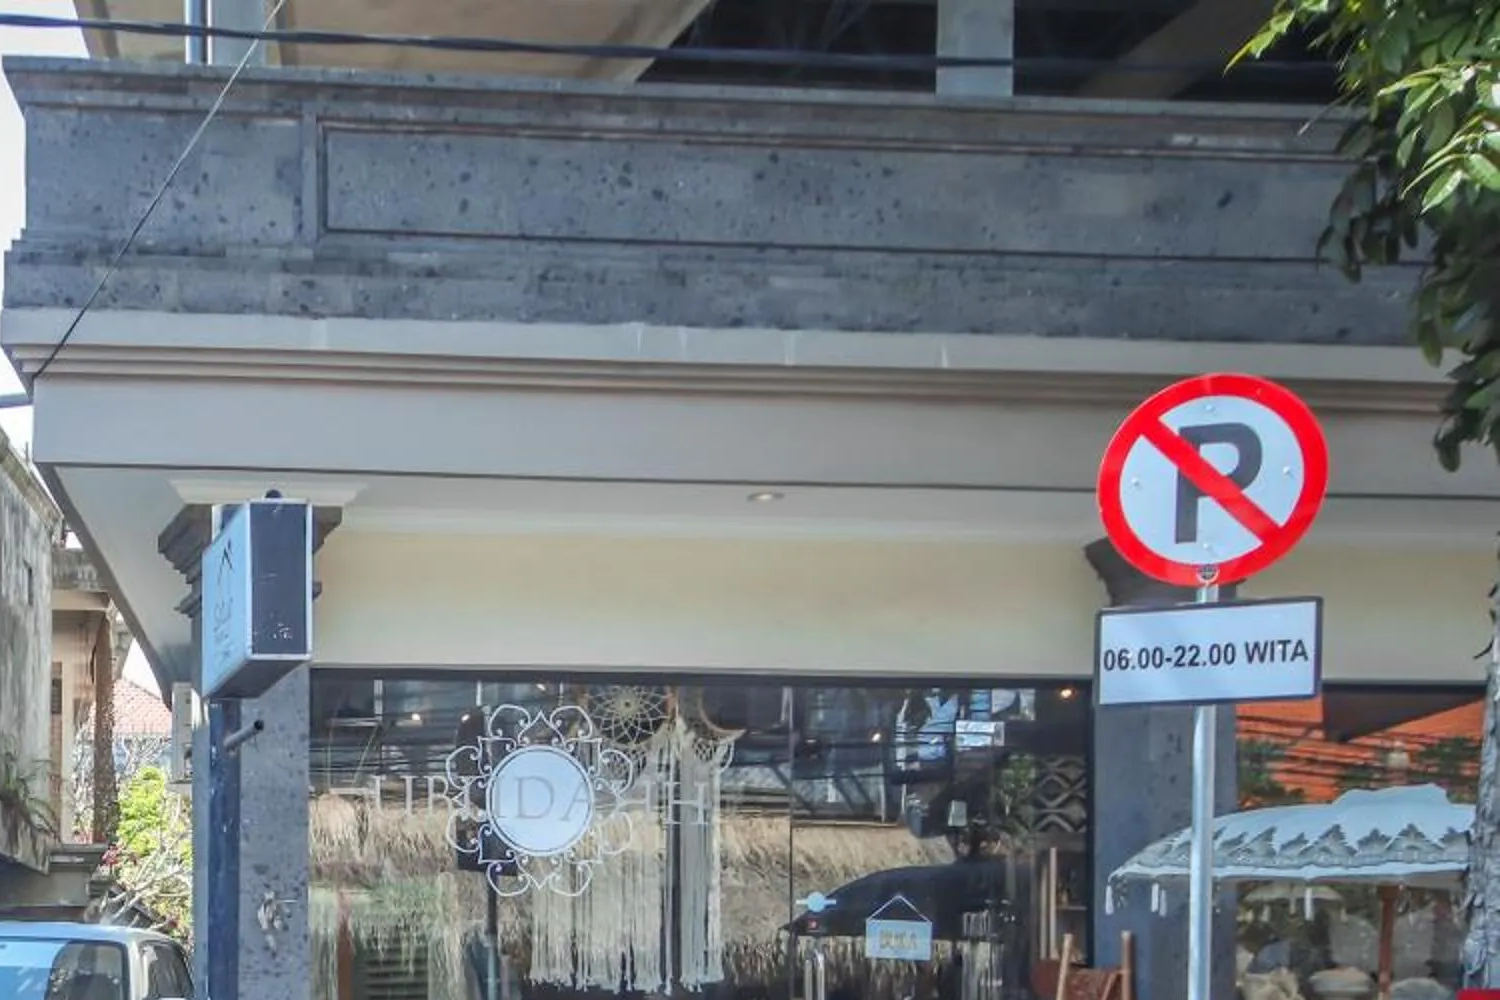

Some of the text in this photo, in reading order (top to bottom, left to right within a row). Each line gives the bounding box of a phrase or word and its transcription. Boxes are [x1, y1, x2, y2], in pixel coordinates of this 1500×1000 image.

[1175, 421, 1263, 544] P
[1103, 639, 1309, 672] 06.00-22.00 WITA
